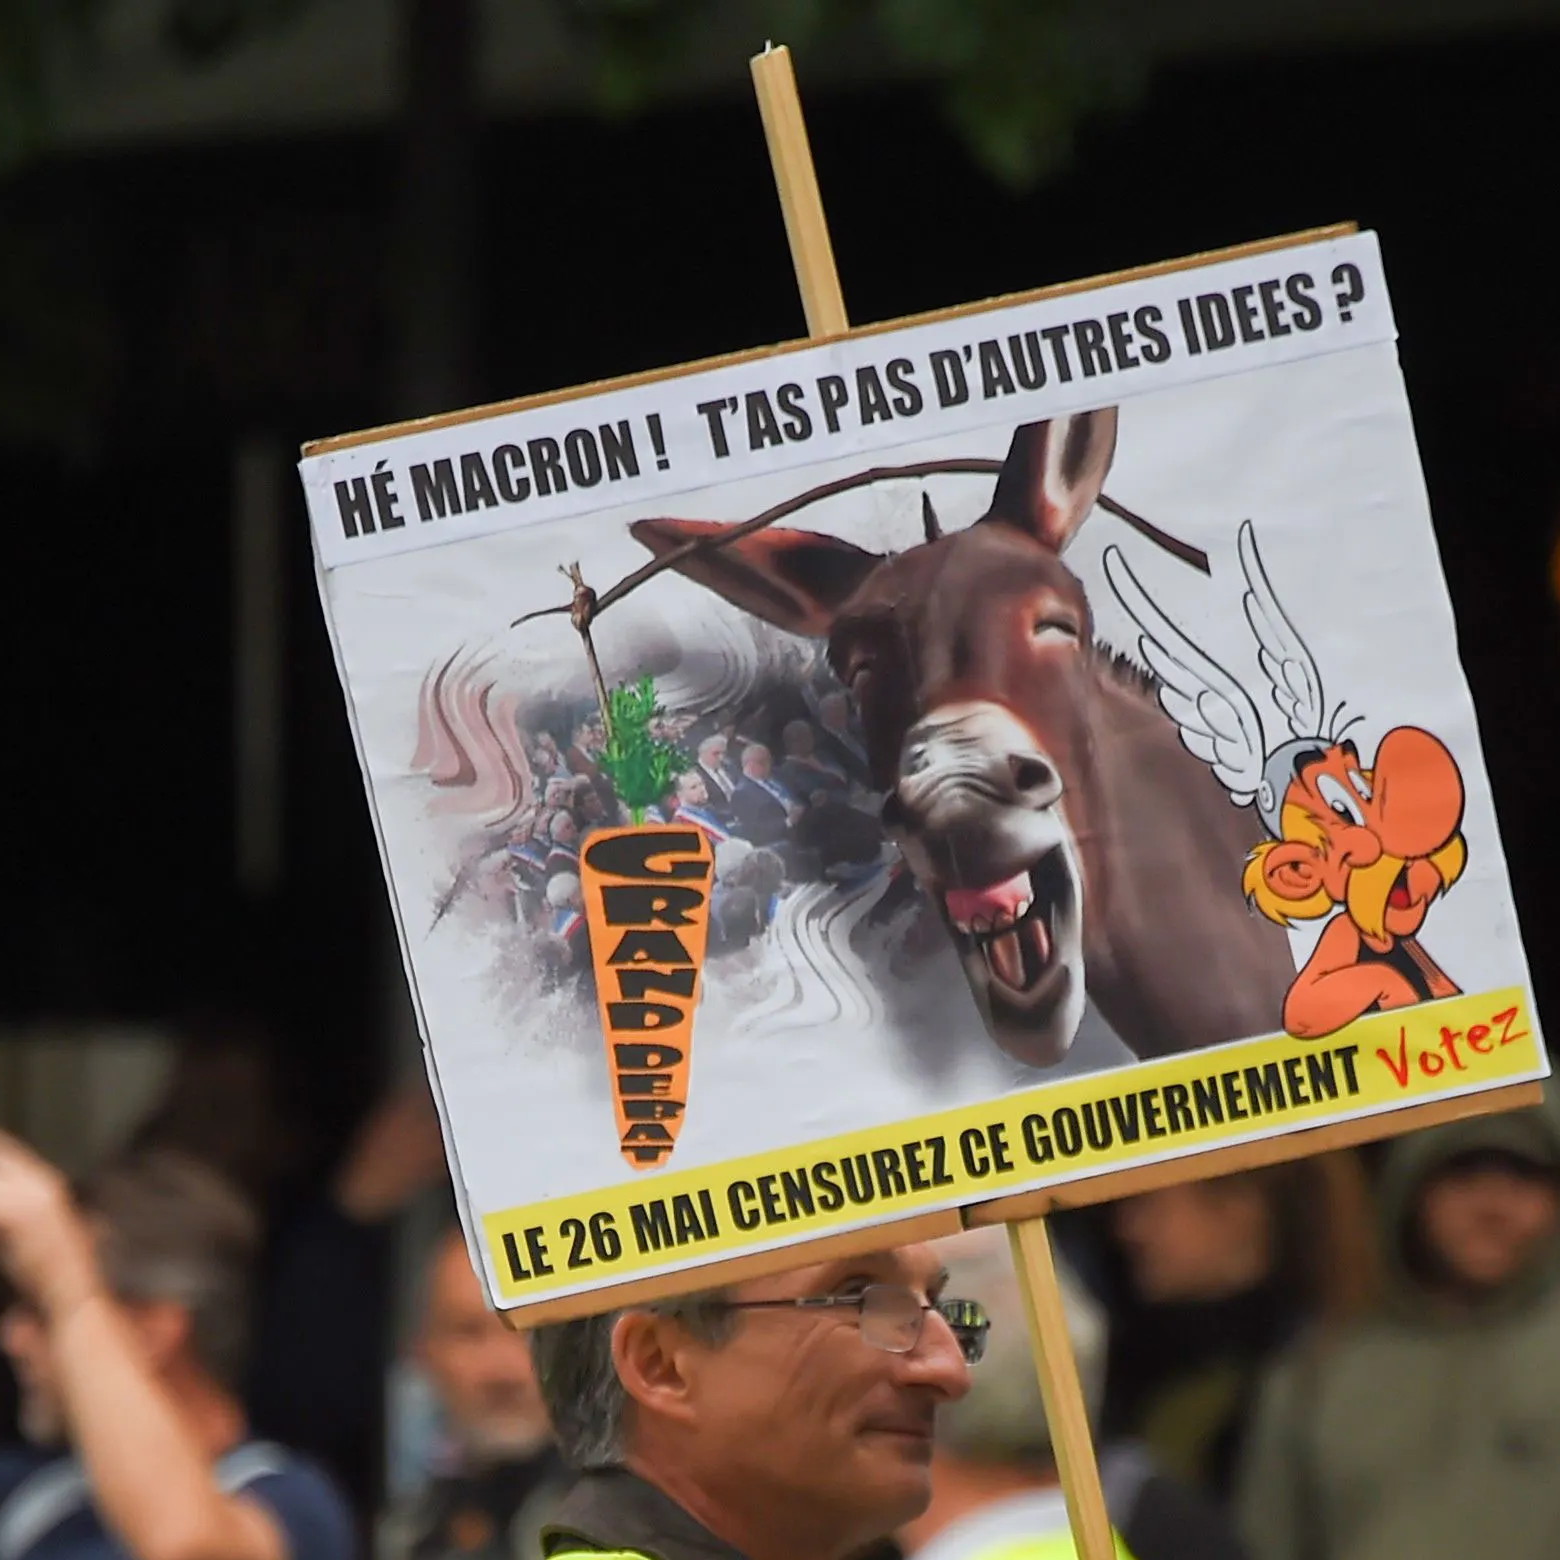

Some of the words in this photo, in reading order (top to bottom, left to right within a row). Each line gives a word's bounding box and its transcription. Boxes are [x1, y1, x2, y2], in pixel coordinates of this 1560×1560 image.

[333, 460, 407, 539] HÉ
[409, 418, 640, 523] MACRON
[645, 413, 670, 470] !
[697, 382, 813, 458] T'AS
[816, 357, 924, 434] PAS
[930, 304, 1173, 407] D'AUTRES
[1177, 270, 1324, 356] IDEES
[1330, 262, 1366, 323] ?
[585, 831, 711, 1031] GRAND
[502, 1226, 553, 1283] LE
[559, 1211, 623, 1270] 26
[628, 1188, 721, 1255] MAI
[728, 1135, 954, 1232] CENSUREZ
[959, 1121, 1015, 1179] CE
[1020, 1044, 1360, 1158] GOUVERNEMENT
[1376, 1006, 1529, 1089] Votez
